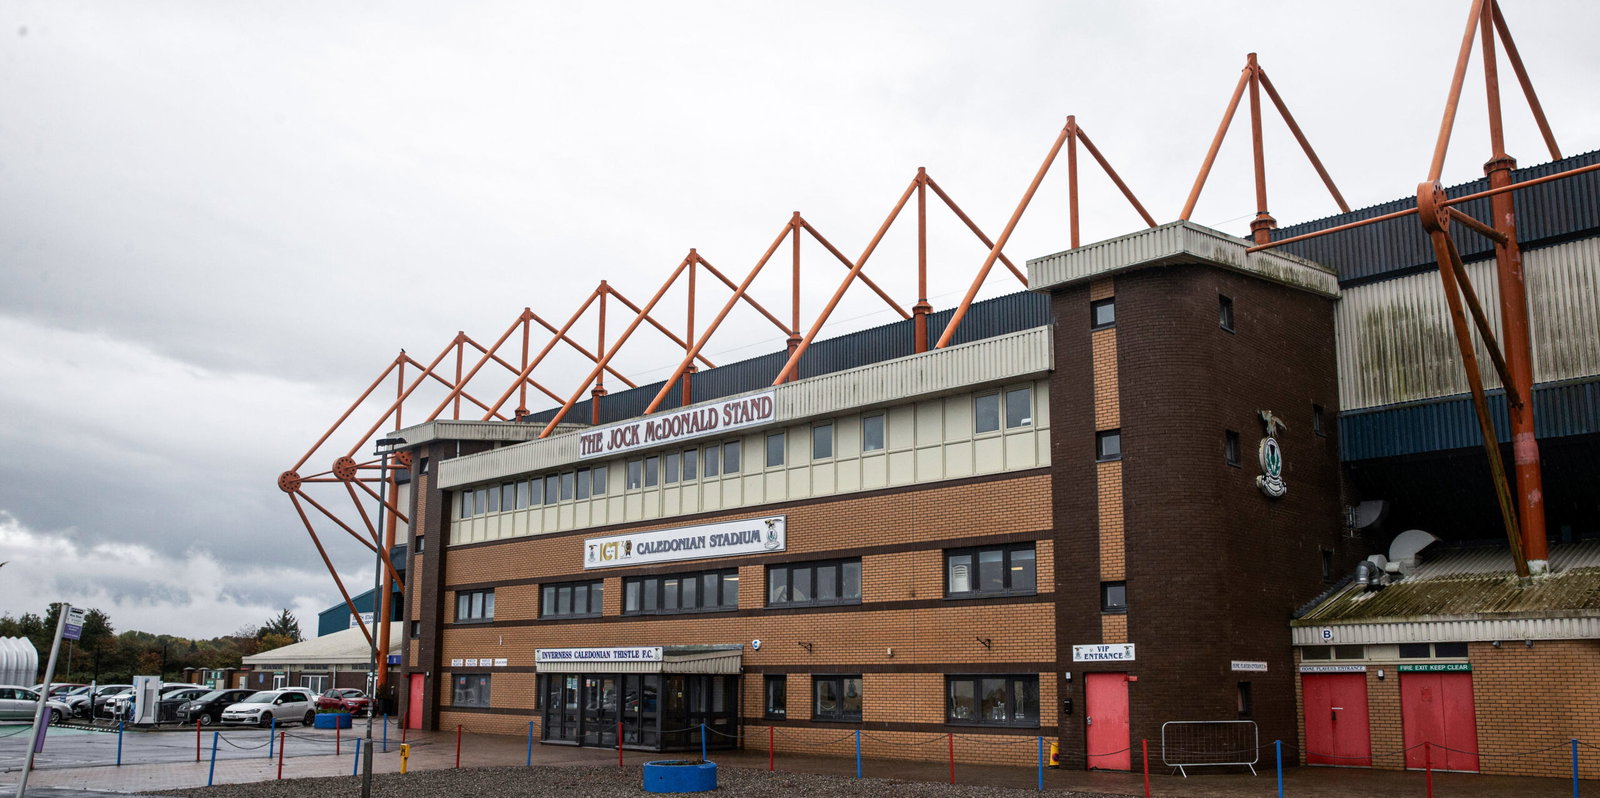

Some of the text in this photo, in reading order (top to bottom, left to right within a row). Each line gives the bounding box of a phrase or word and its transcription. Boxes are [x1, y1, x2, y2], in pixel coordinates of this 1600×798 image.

[580, 395, 773, 455] THE JOCK McDONALD STAND
[599, 541, 620, 561] ICT
[636, 536, 706, 555] CALEDONIAN
[709, 530, 762, 548] STADIUM
[1323, 630, 1331, 638] B
[541, 649, 653, 659] INVERNESS CALEDONIAN THISTLE F.C.
